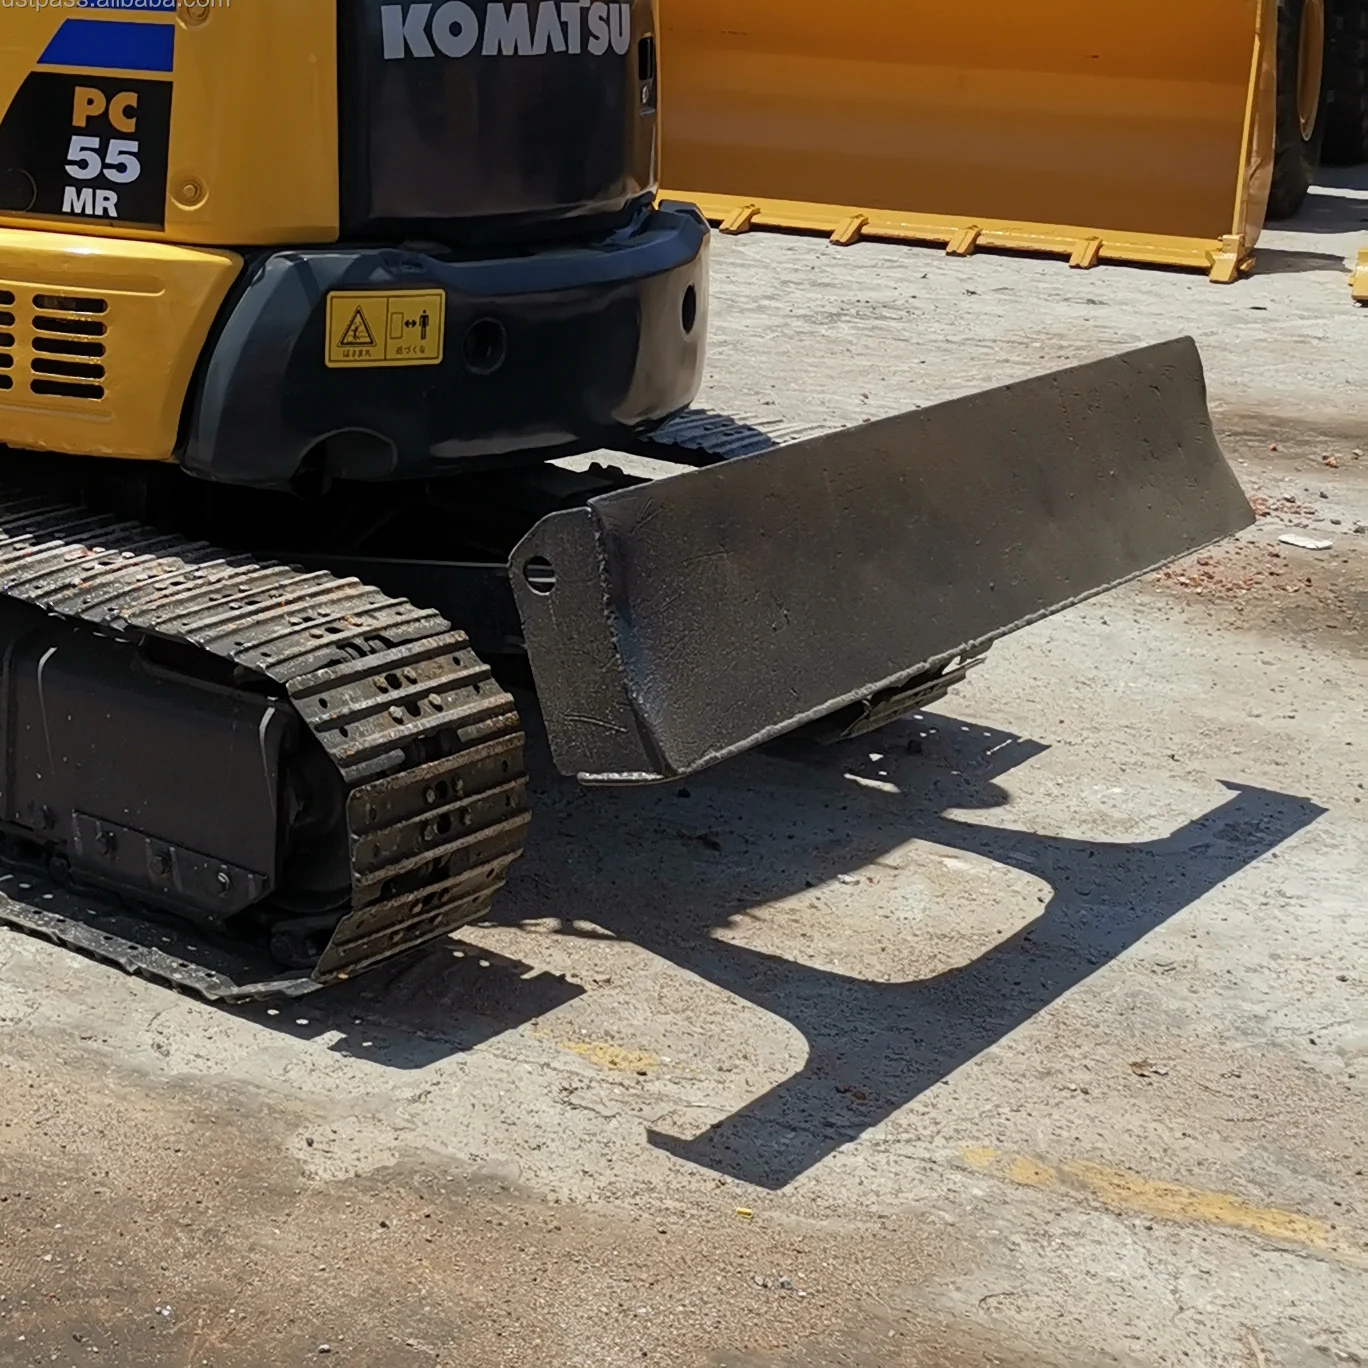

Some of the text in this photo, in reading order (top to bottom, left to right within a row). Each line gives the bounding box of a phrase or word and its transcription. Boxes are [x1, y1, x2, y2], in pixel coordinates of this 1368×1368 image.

[72, 86, 138, 133] PC
[64, 135, 141, 183] 55
[62, 186, 118, 218] MR
